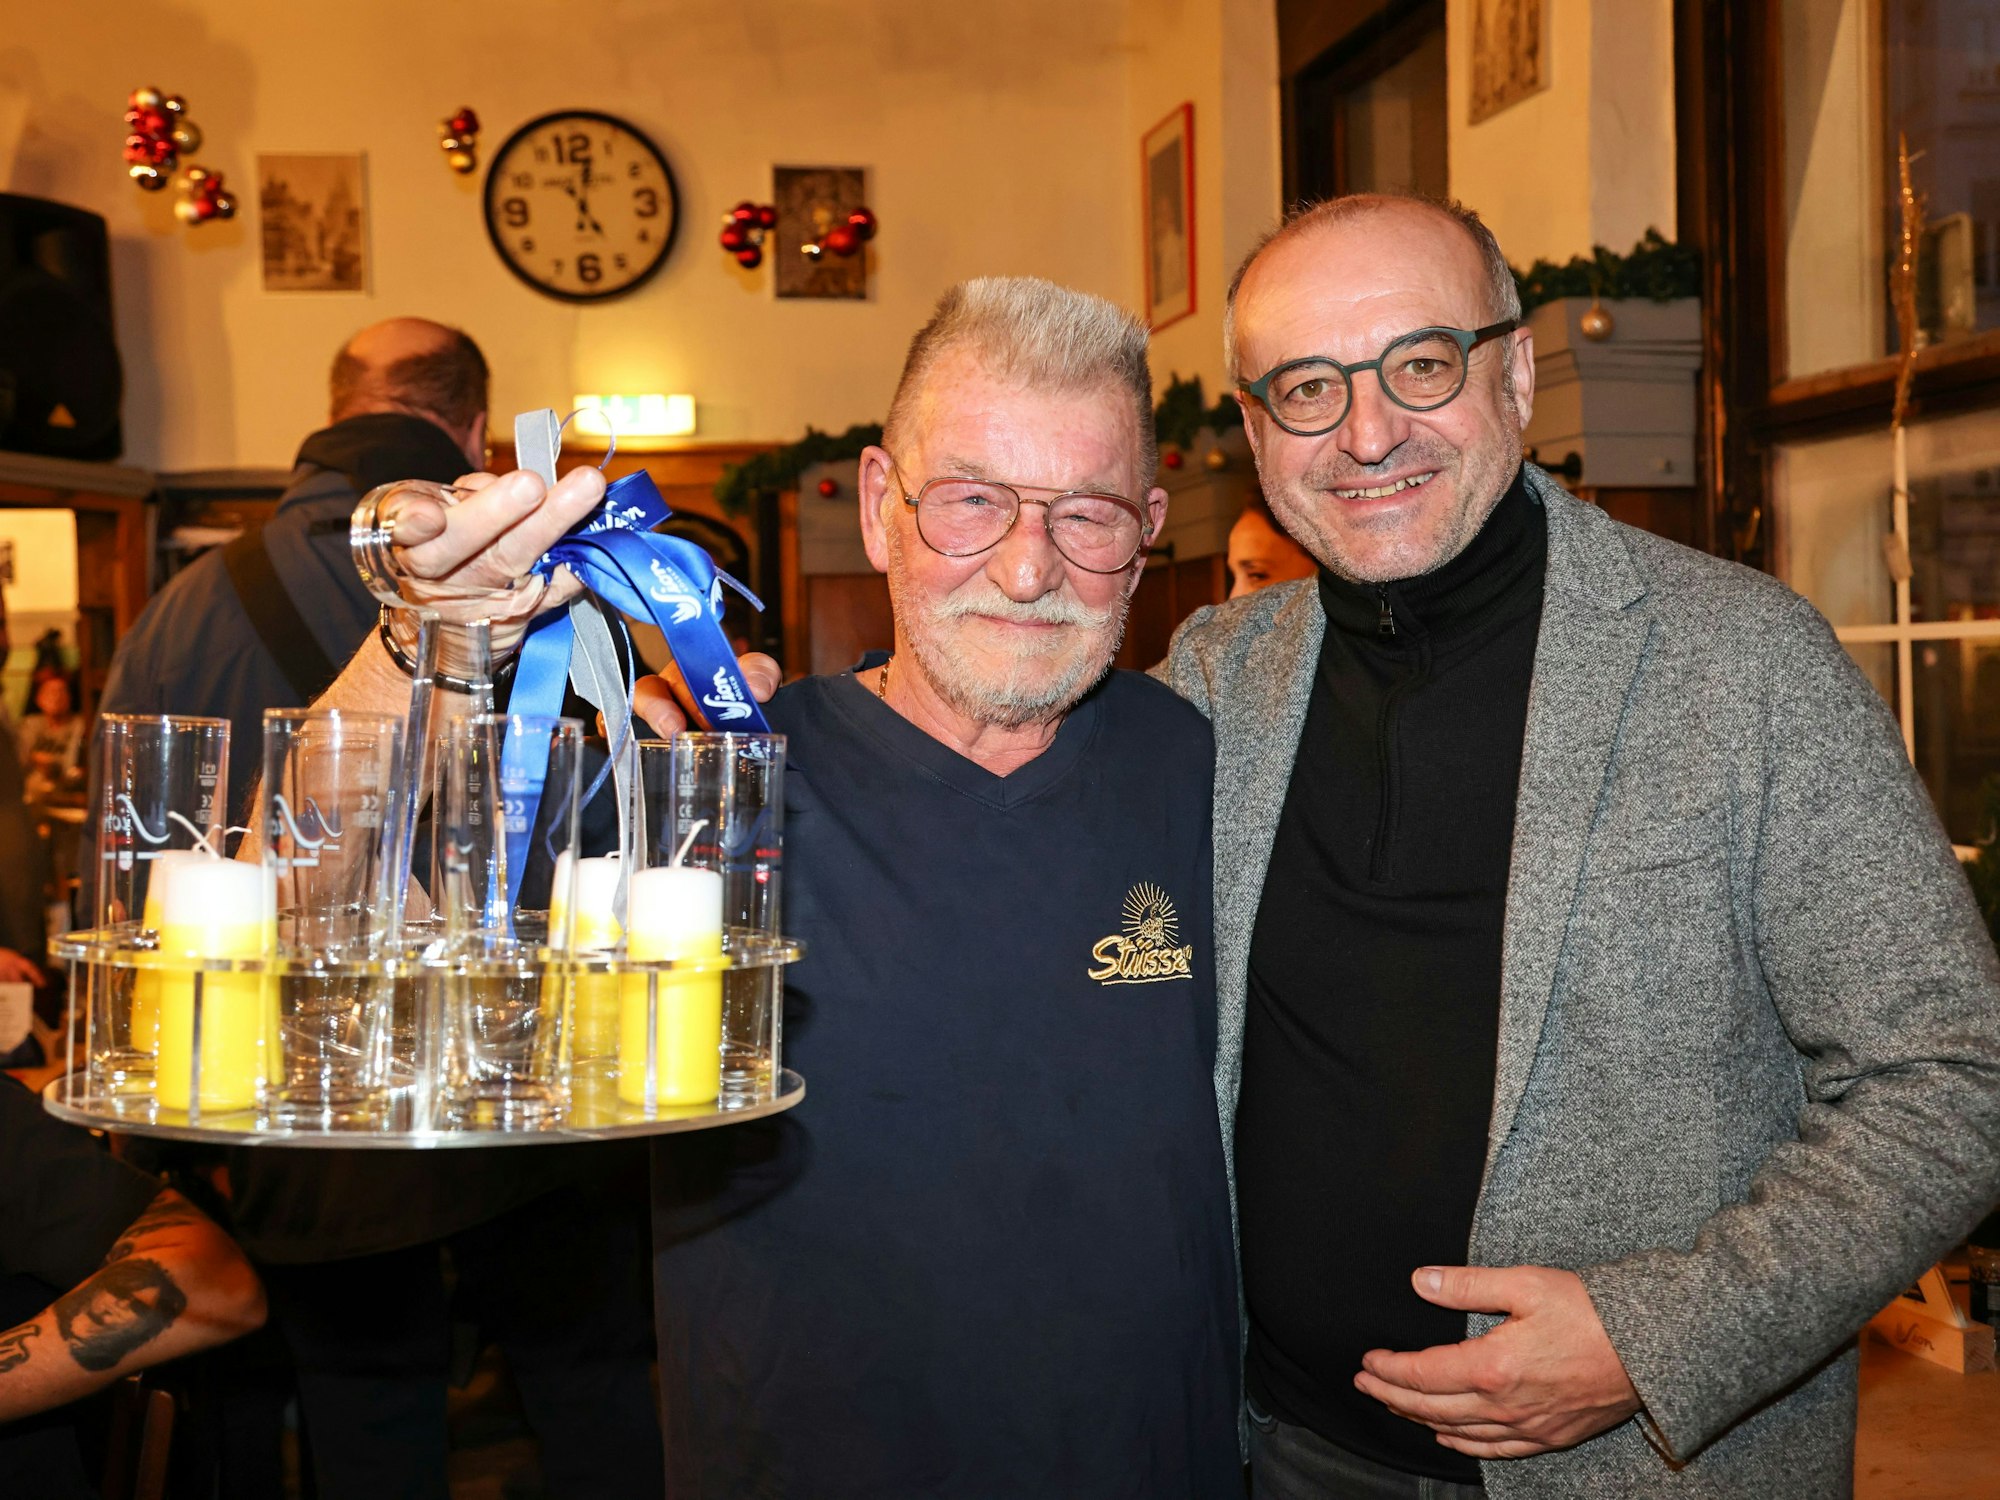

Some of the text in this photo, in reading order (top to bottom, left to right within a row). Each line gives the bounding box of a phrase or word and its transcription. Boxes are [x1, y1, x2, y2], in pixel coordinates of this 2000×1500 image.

[553, 133, 591, 164] 12
[504, 197, 529, 228] 9
[632, 187, 659, 219] 3
[576, 253, 602, 284] 6
[703, 666, 753, 721] Sion
